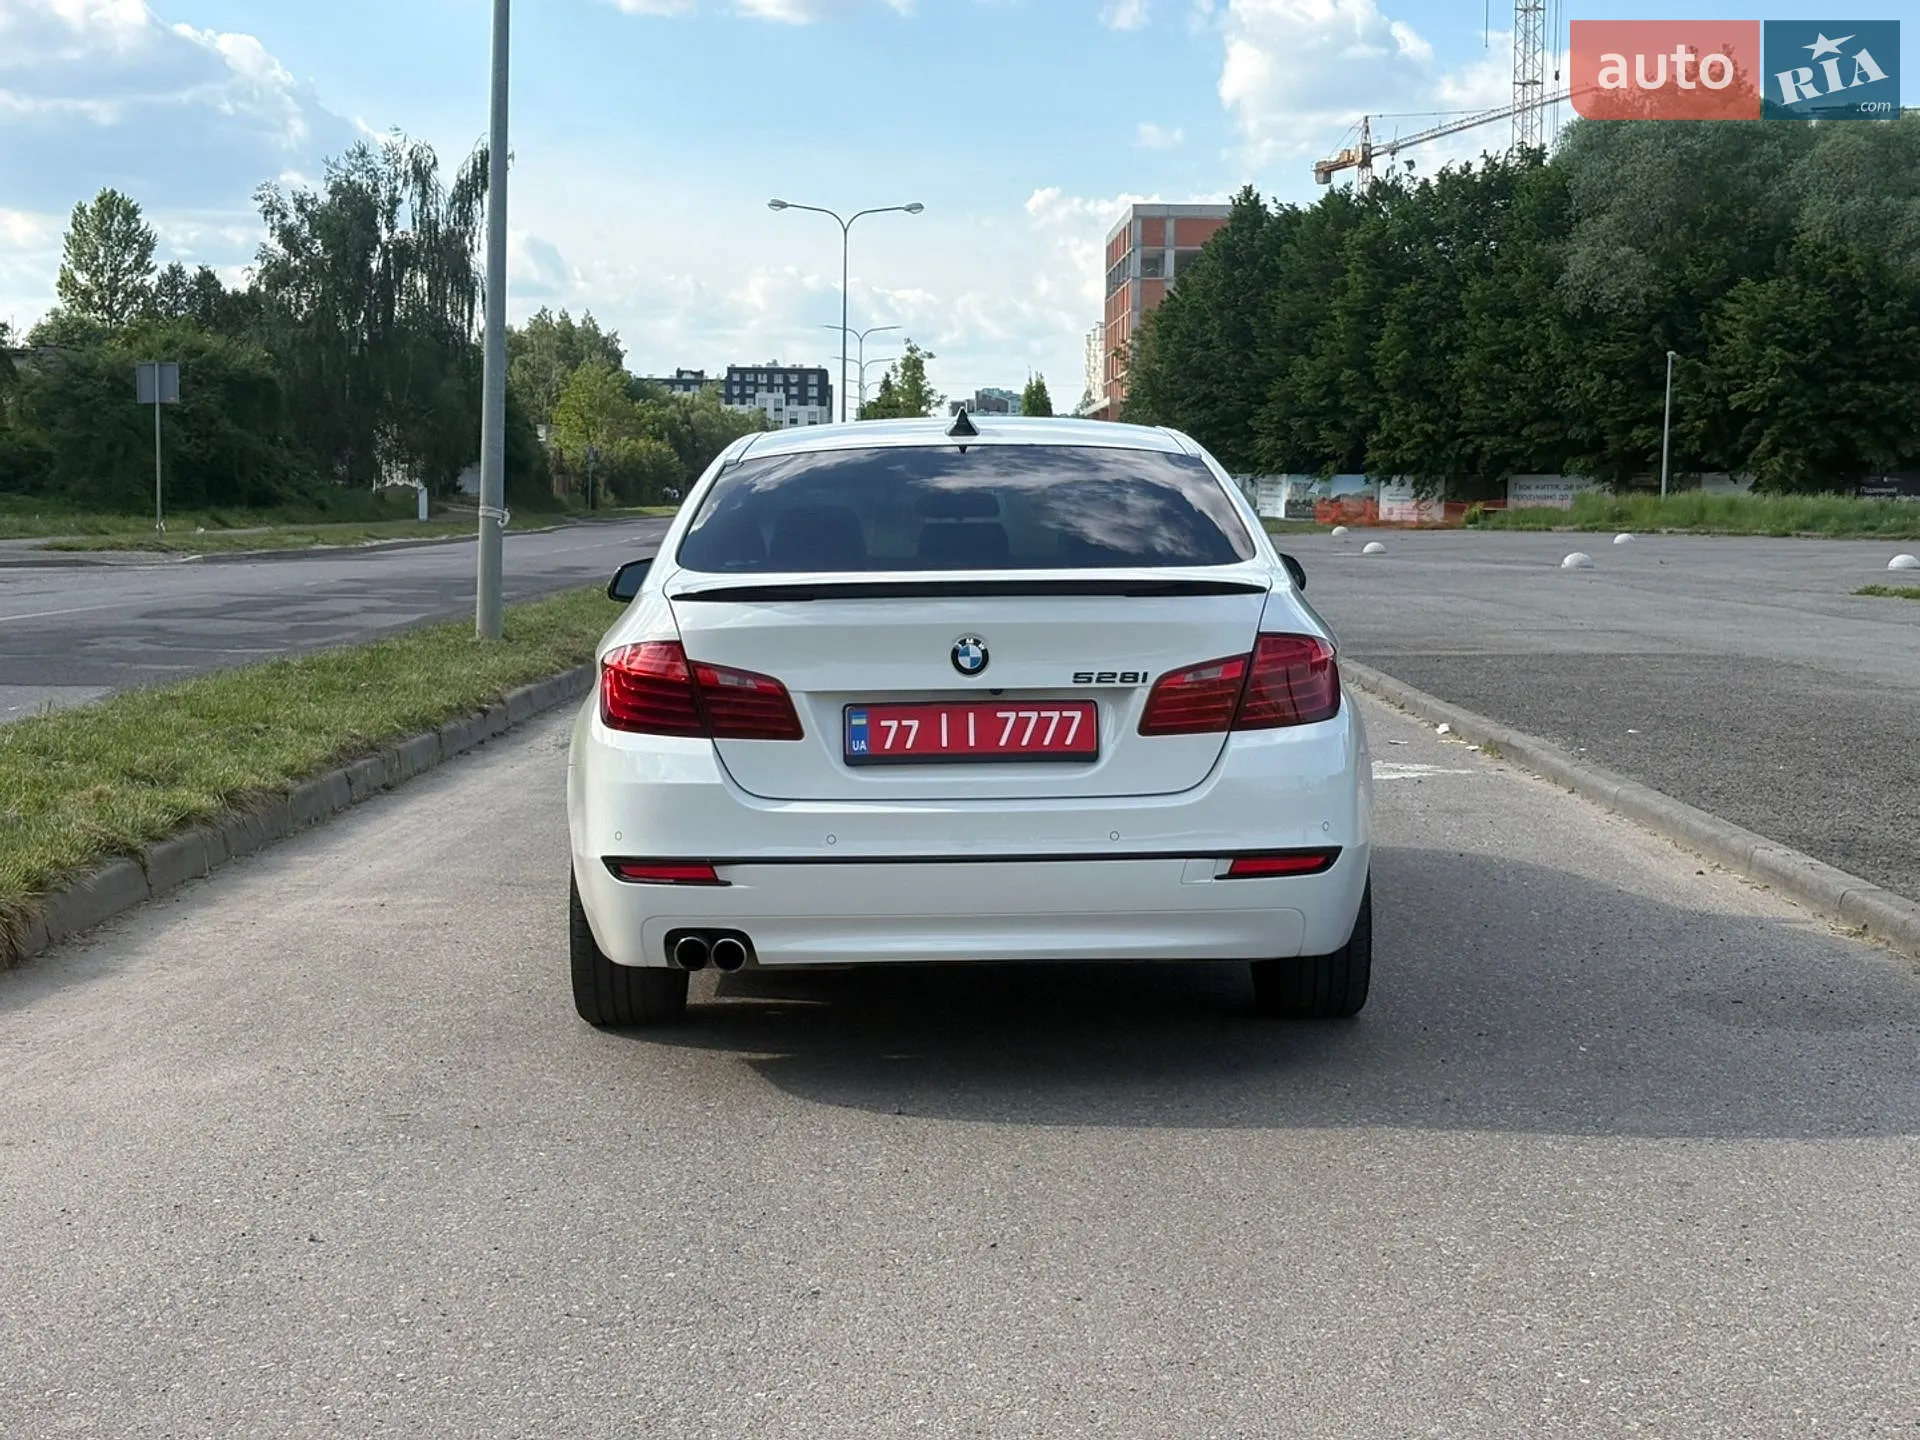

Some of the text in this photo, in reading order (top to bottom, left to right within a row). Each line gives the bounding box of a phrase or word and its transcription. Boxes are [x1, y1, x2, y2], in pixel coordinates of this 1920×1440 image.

[880, 719, 920, 750] 77
[996, 710, 1082, 747] 7777
[852, 739, 867, 751] UA
